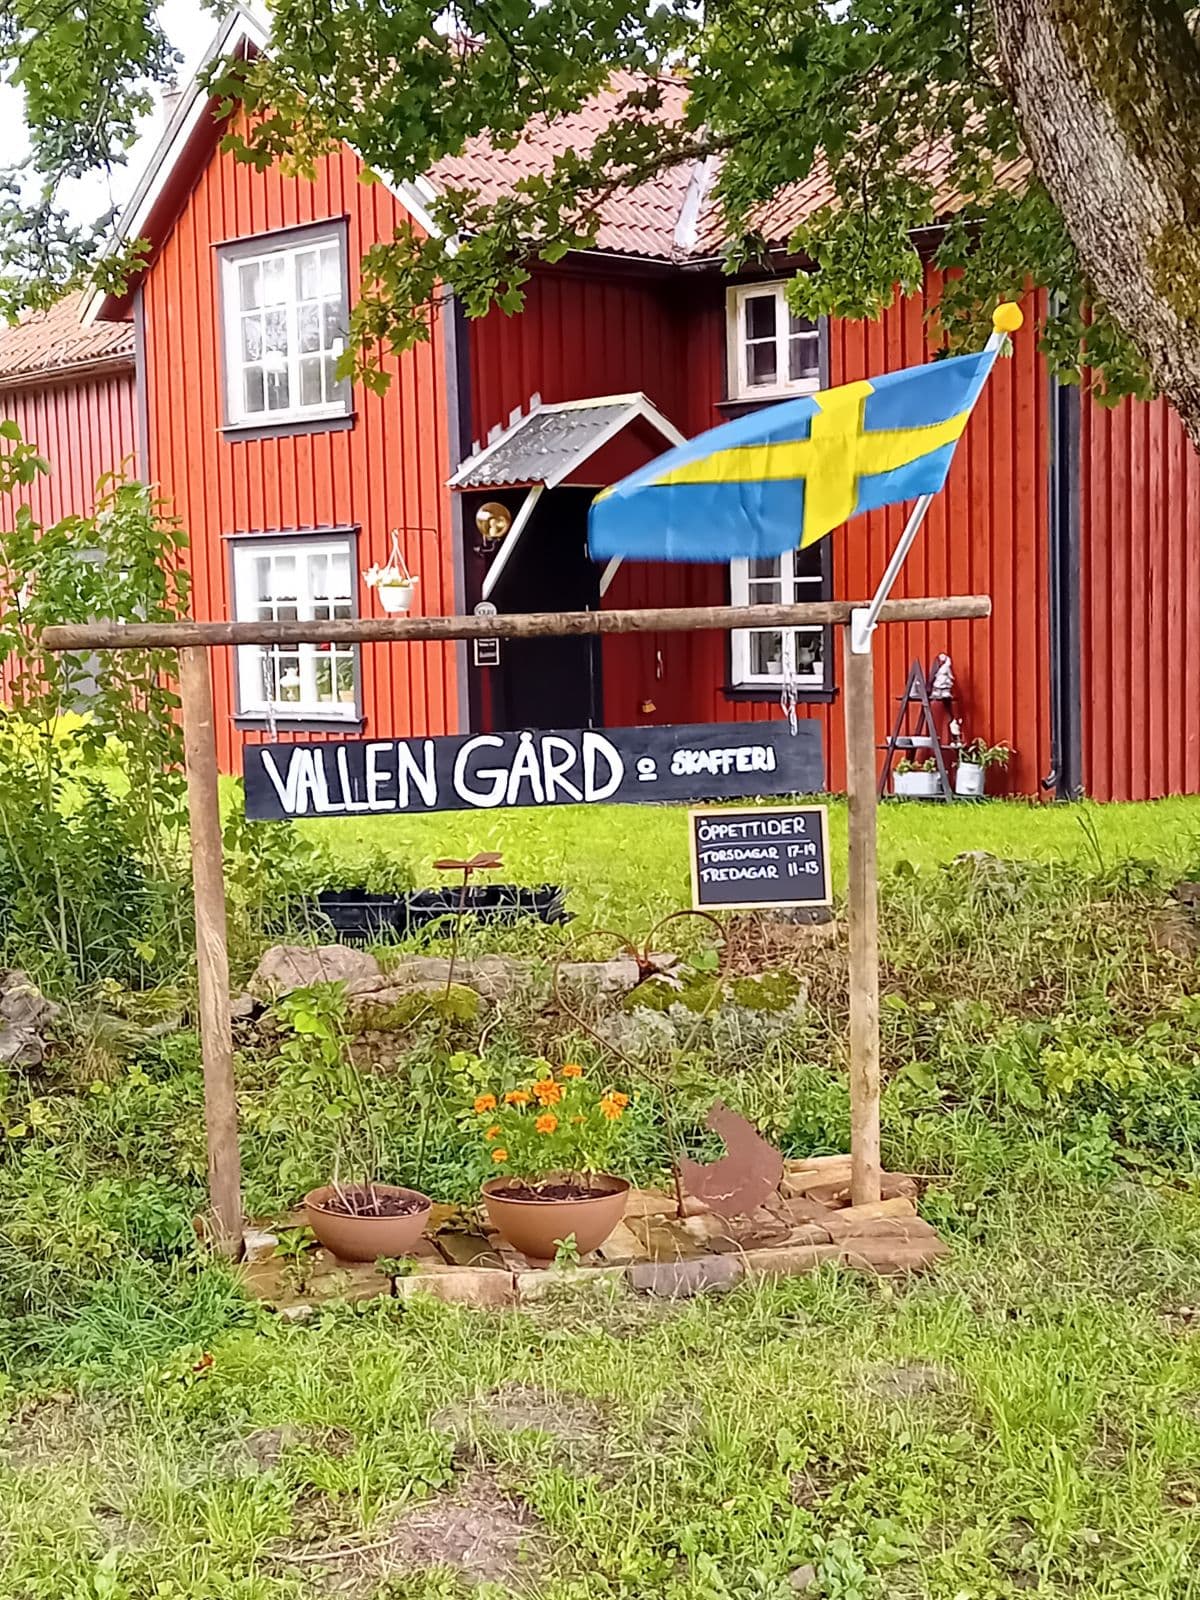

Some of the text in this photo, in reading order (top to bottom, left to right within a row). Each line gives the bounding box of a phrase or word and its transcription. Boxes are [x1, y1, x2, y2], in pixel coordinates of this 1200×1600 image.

[261, 741, 438, 812] VALLEN
[454, 733, 623, 806] GÅRD
[670, 746, 776, 776] SKAFFERI
[698, 816, 806, 841] ÖPPETTIDER
[698, 842, 817, 864] TORSDAGAR 17-19
[700, 865, 780, 883] FREDAGAR
